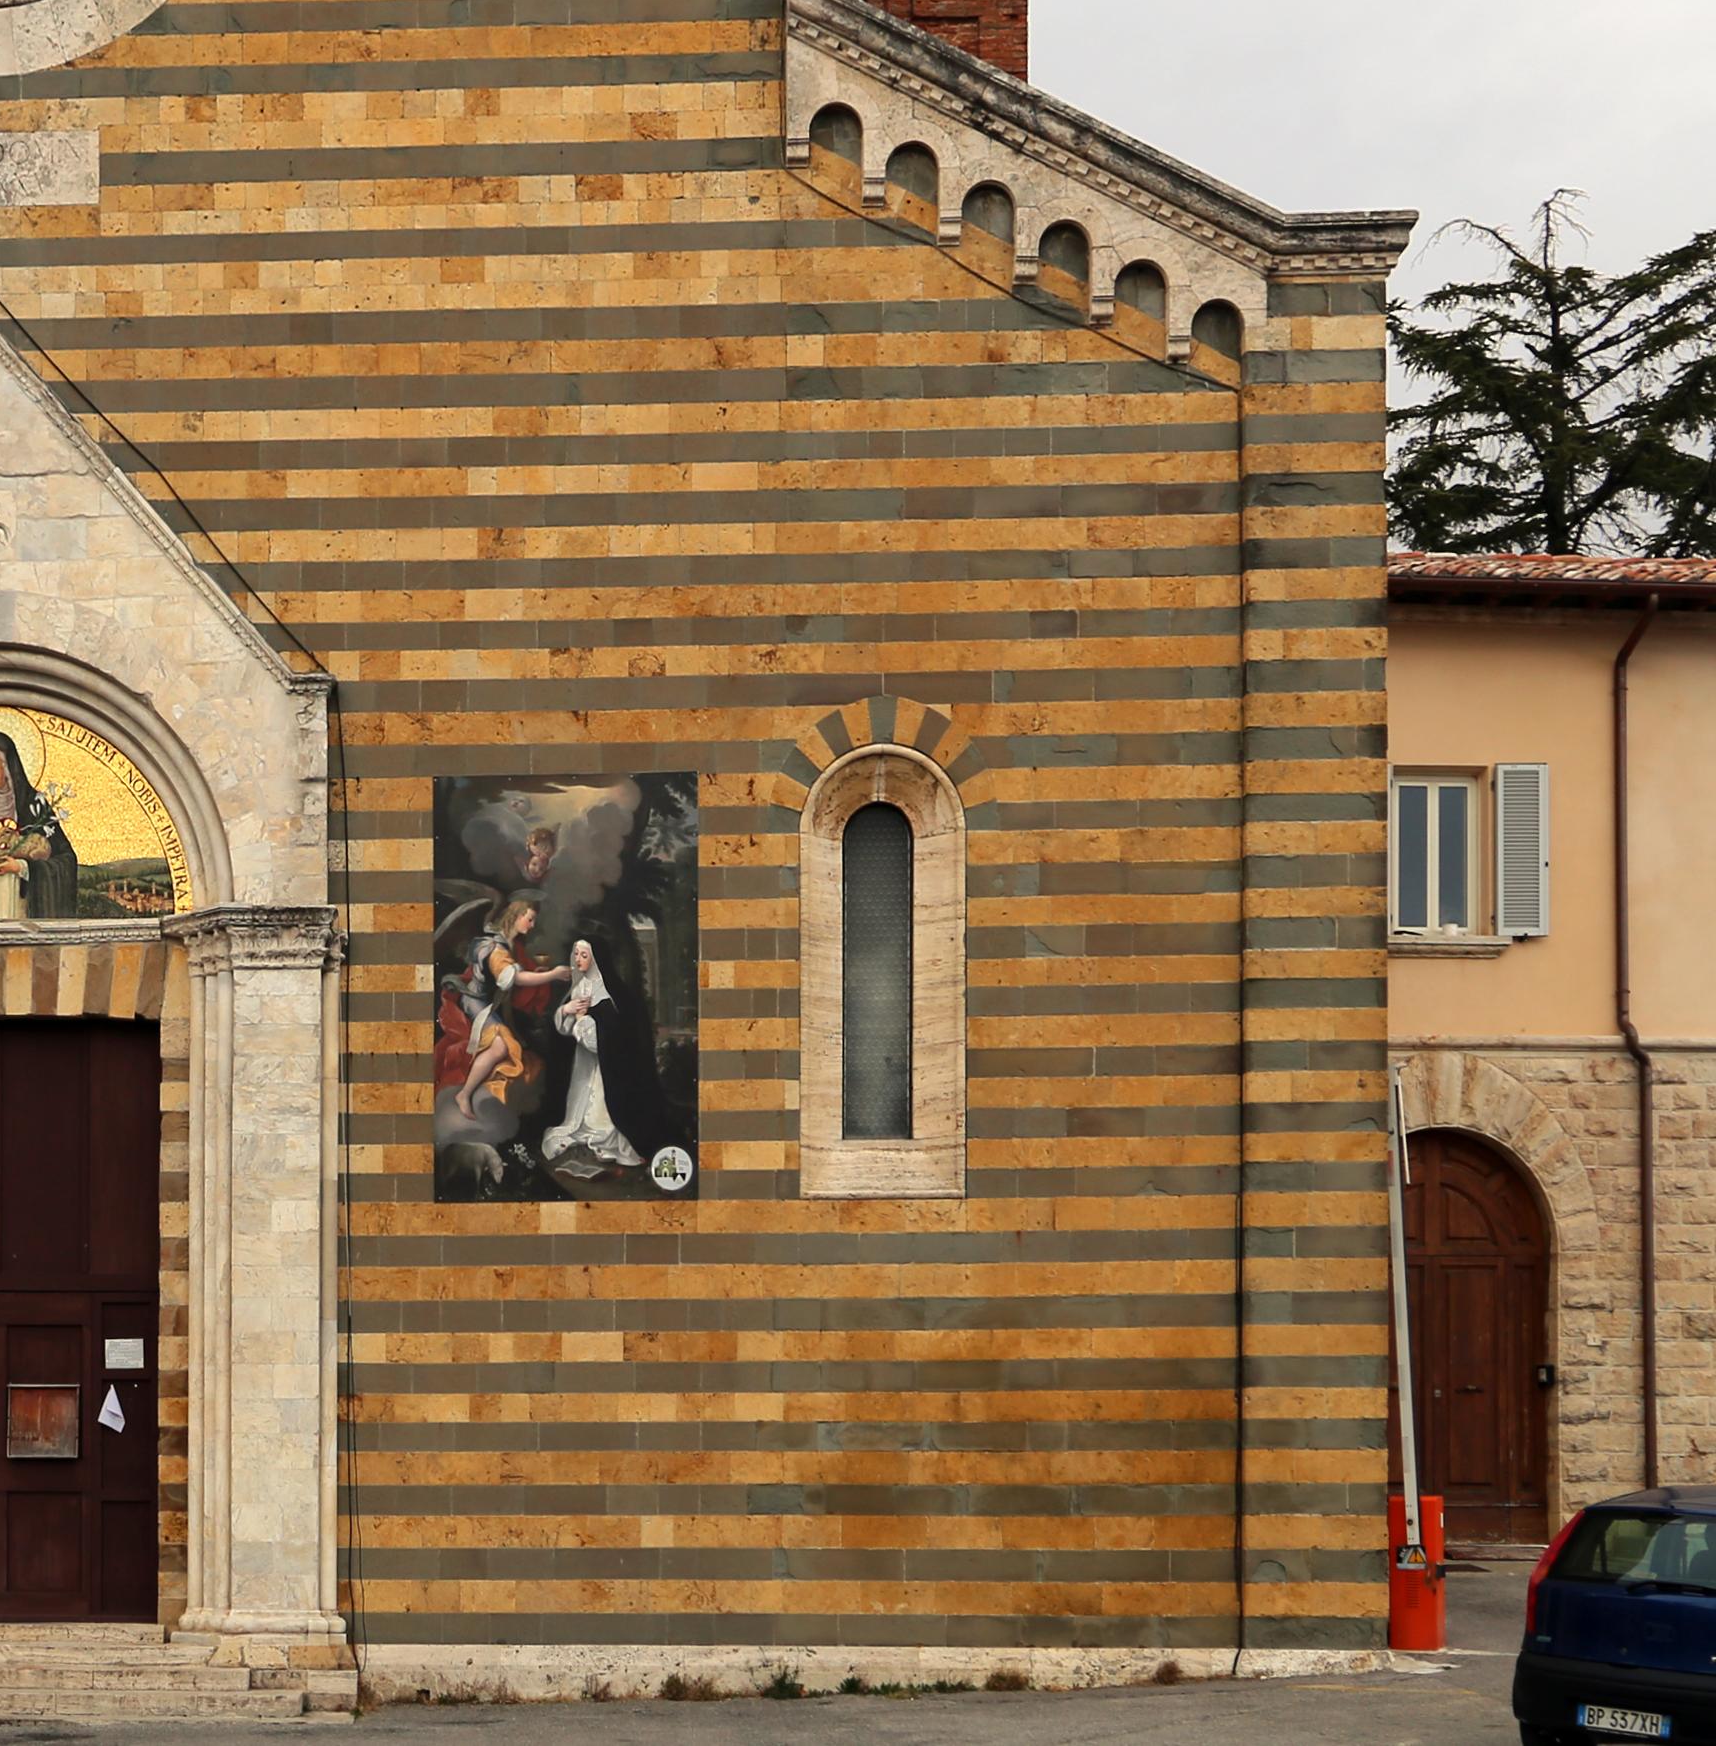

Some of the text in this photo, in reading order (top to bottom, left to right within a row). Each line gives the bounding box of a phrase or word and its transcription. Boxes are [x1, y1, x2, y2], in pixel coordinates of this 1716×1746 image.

[46, 717, 189, 901] SALUTEM NOBIS IMPETRA
[1586, 1707, 1660, 1734] BP 537XH
